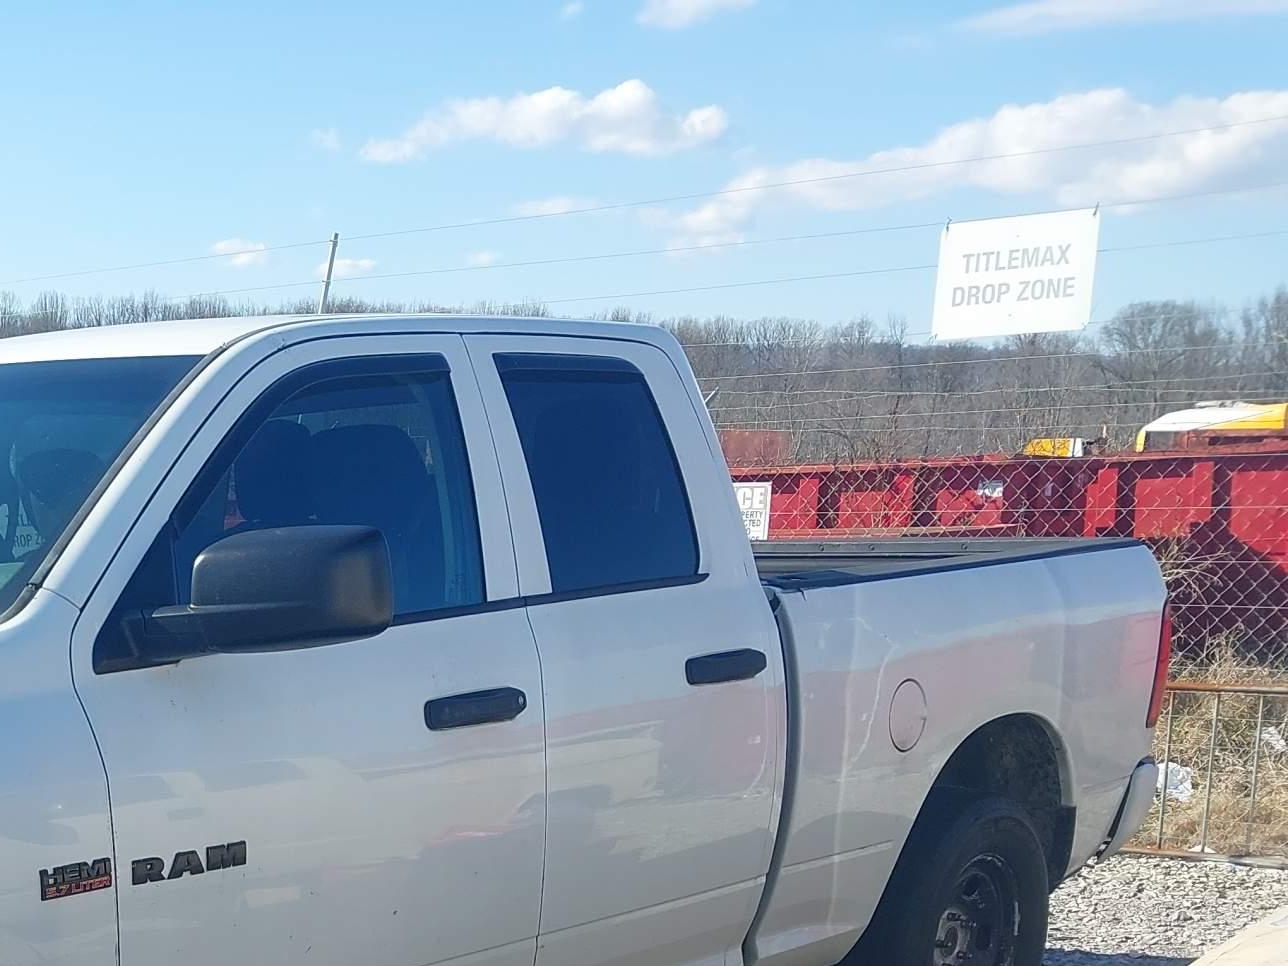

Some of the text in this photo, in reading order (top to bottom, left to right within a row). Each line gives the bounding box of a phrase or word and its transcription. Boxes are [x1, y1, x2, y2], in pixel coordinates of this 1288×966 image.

[962, 243, 1072, 274] TITLEMAX
[951, 277, 1076, 308] DROP ZONE
[39, 857, 112, 887] HEMI
[132, 840, 247, 886] RAM
[45, 874, 111, 898] 5.7 LITER
